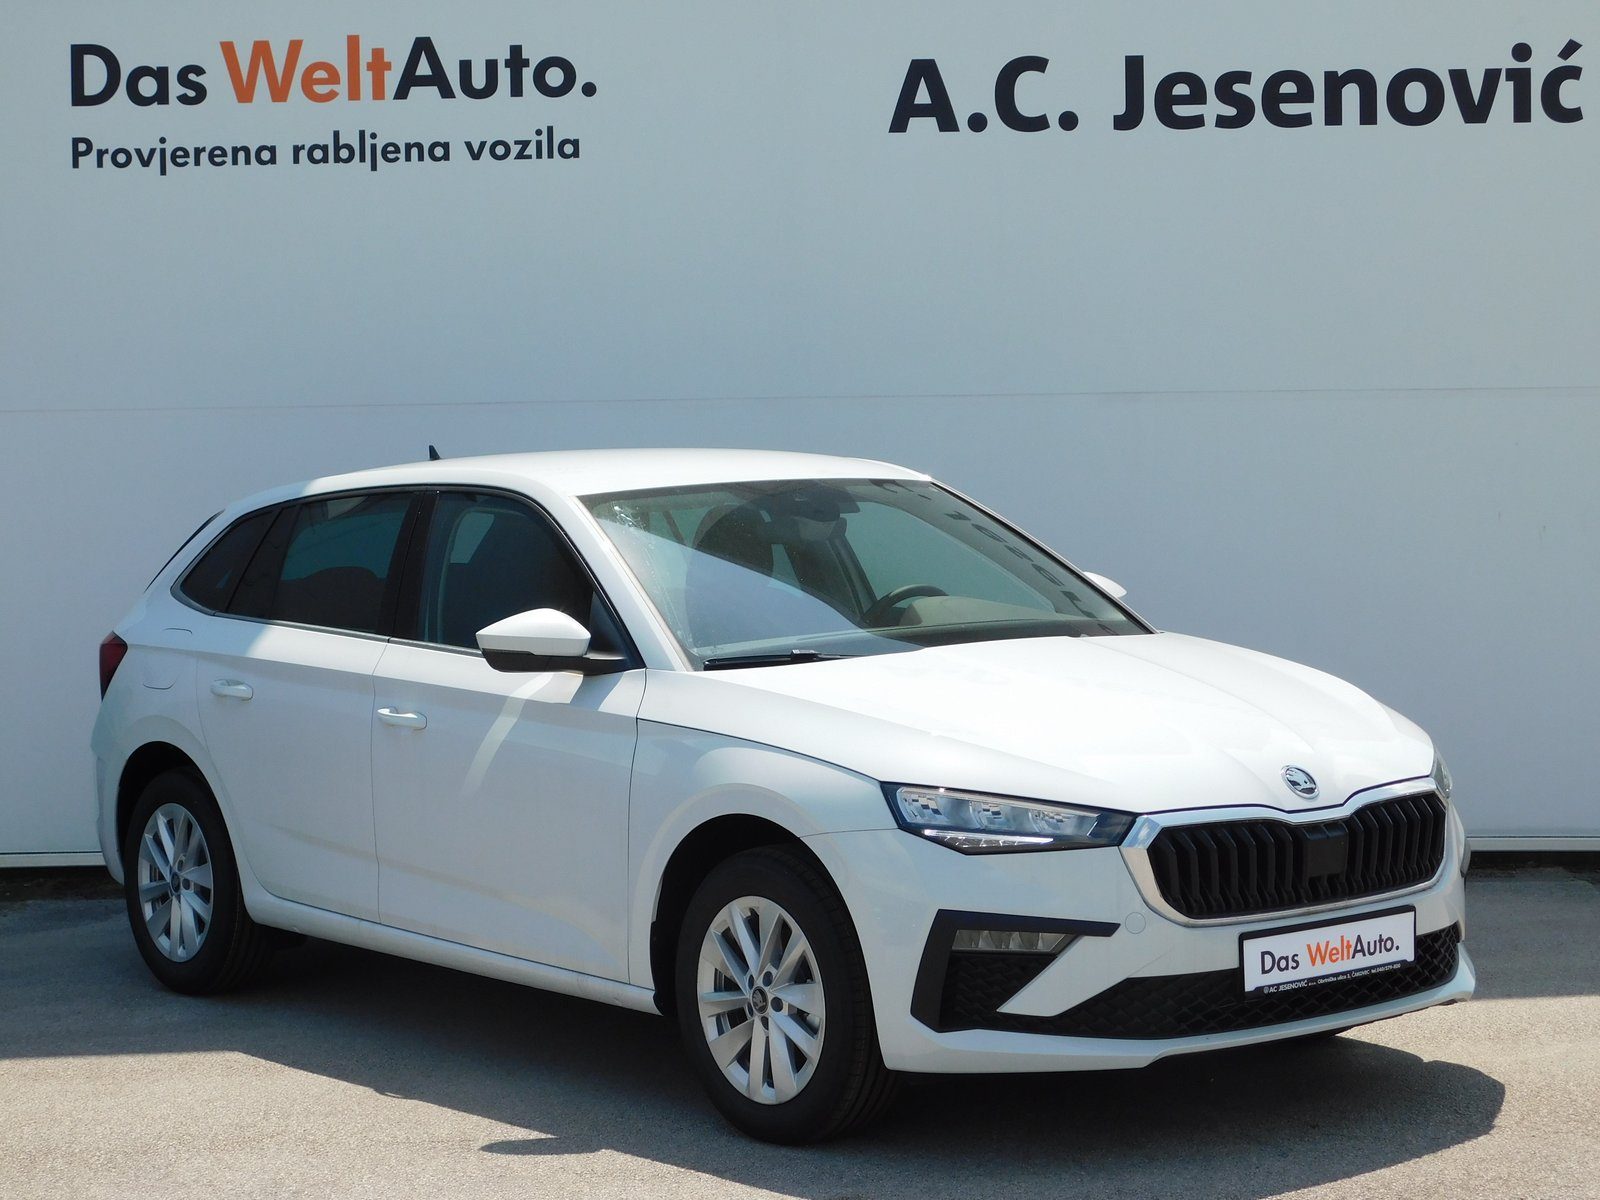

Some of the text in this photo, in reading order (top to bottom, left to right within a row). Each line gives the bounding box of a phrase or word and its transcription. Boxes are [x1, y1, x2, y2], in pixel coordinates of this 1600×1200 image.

[71, 35, 597, 106] Das WeltAuto.
[887, 39, 1584, 133] A.C. Jesenović
[72, 126, 580, 176] Provjerena rabljena vozila
[1261, 934, 1400, 975] Das WeltAuto.
